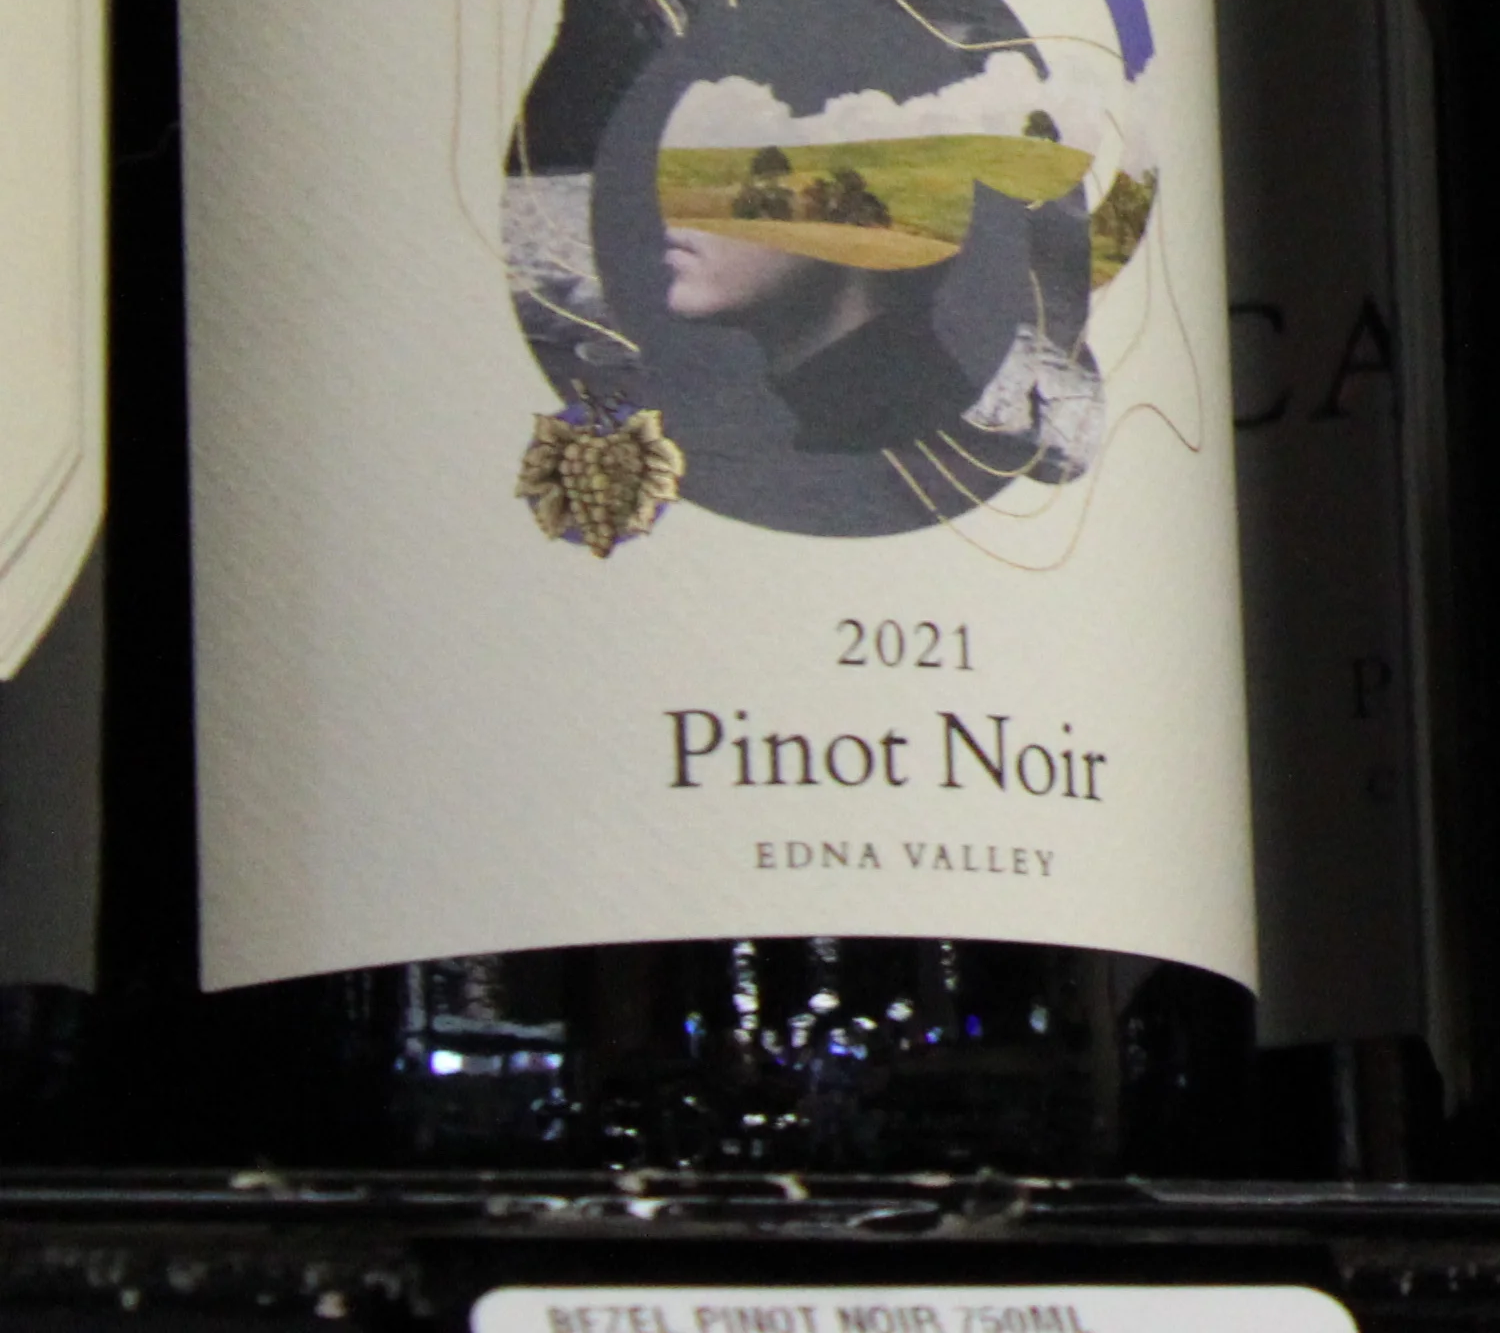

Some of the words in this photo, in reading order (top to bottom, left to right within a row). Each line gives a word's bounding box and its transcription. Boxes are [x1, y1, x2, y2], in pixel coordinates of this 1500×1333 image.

[834, 618, 976, 671] 2021
[663, 708, 910, 789] Pinot
[936, 710, 1107, 803] Noir
[755, 841, 883, 871] EDNA
[904, 842, 1055, 878] VALLEY
